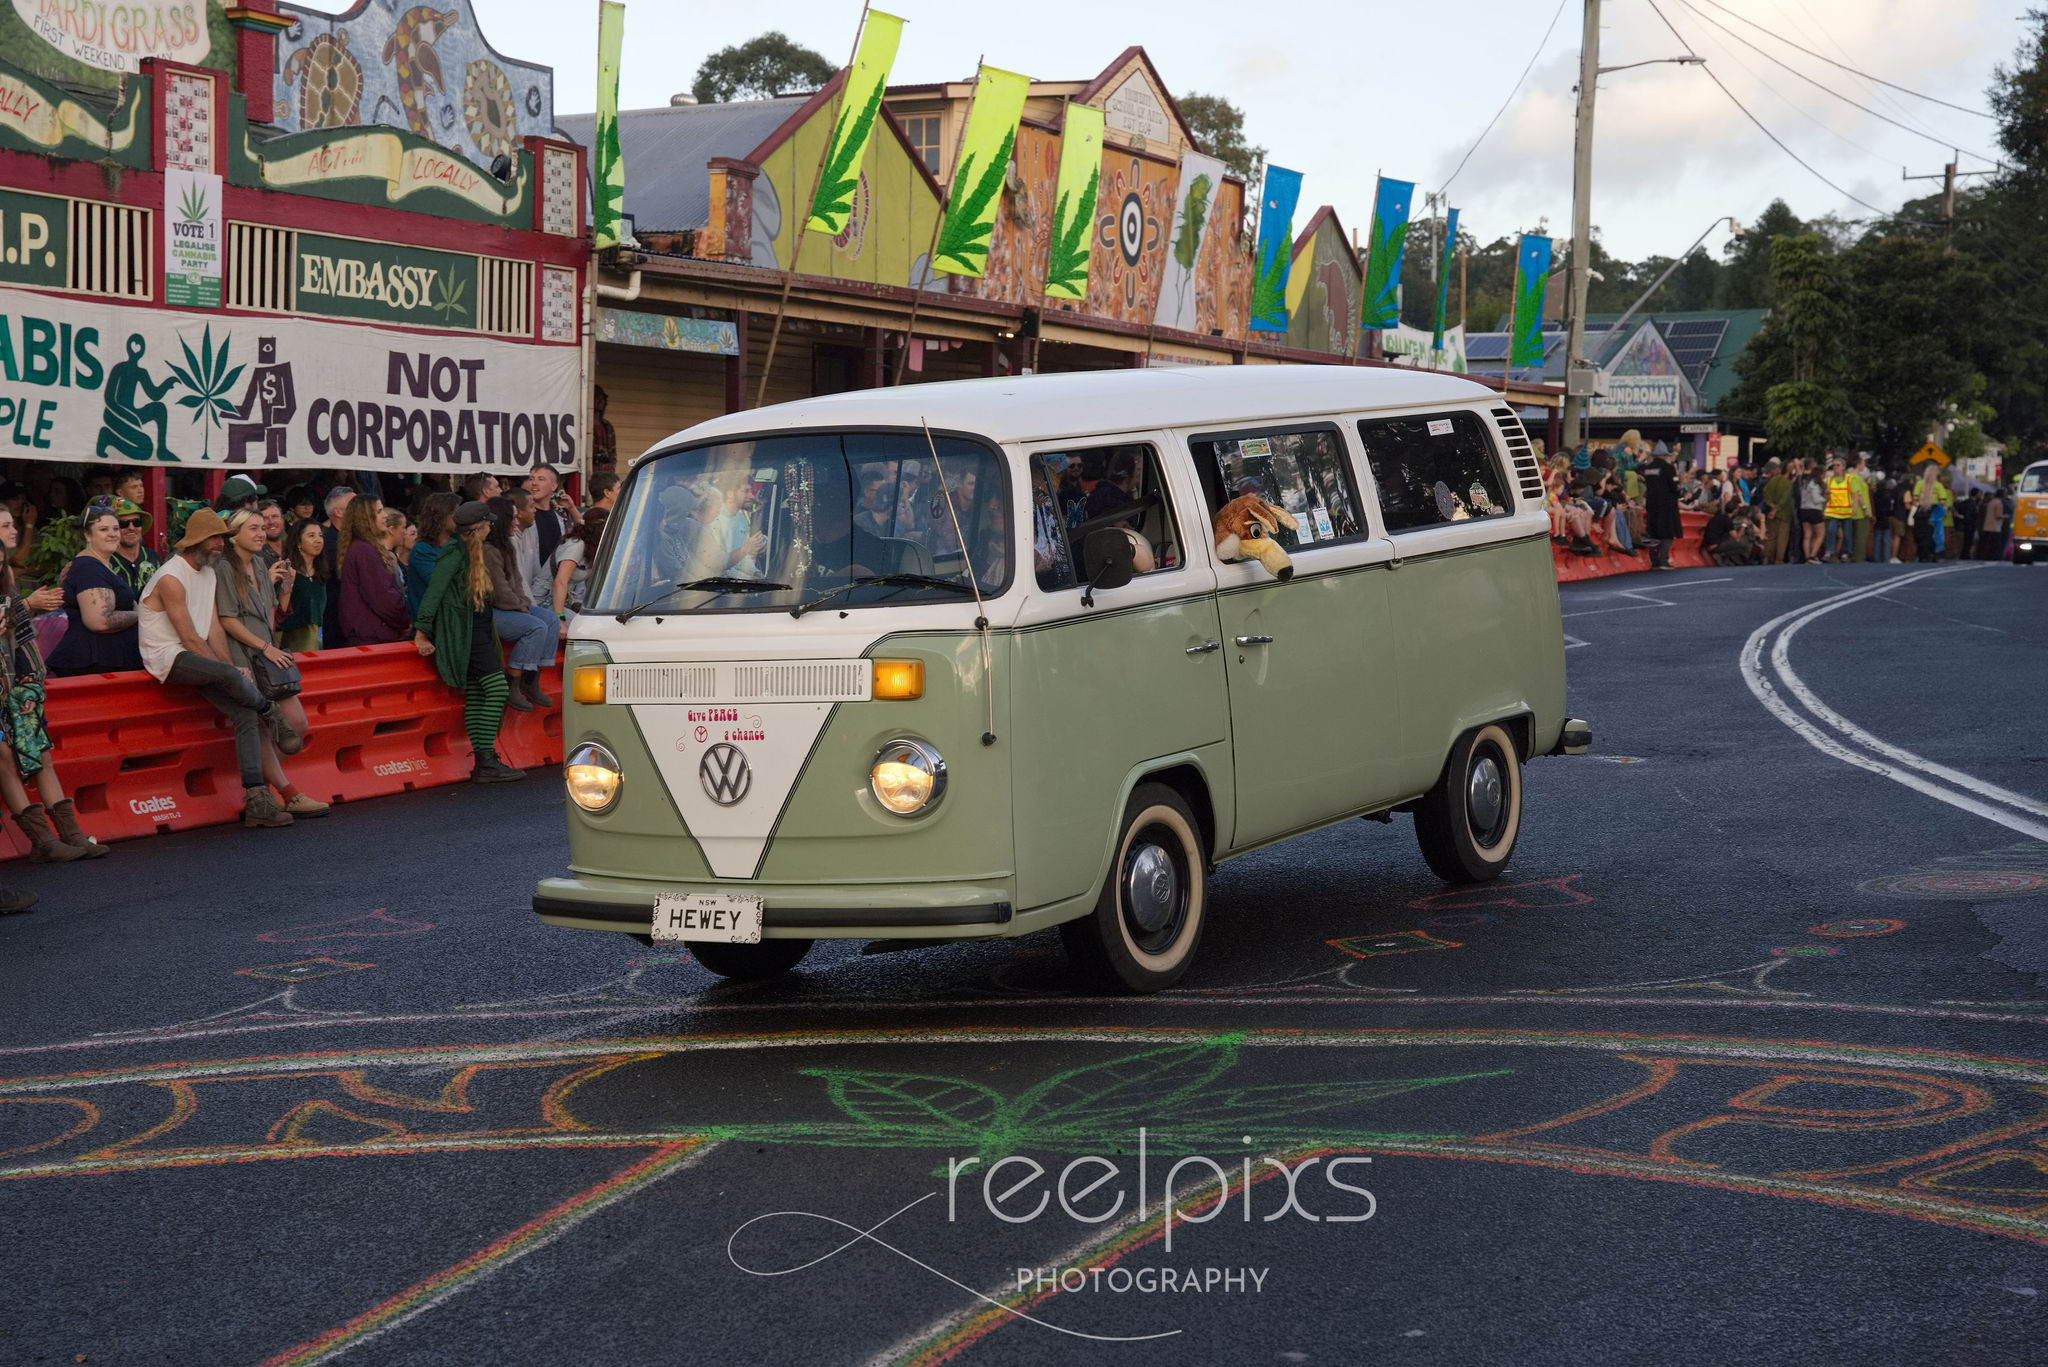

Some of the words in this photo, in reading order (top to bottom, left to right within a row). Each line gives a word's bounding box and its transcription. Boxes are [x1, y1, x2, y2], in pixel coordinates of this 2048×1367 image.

[111, 5, 200, 51] GRASS
[33, 15, 65, 46] FIRST
[72, 40, 125, 70] WEEKEND
[412, 156, 480, 192] LOCALLY
[0, 209, 56, 268] .P.
[172, 222, 205, 239] VOTE
[209, 222, 214, 239] 1
[171, 249, 217, 261] CANNABIS
[173, 239, 216, 252] LEGALISE
[181, 259, 208, 269] PARTY
[300, 253, 437, 310] EMBASSY
[386, 350, 485, 403] NOT
[1593, 384, 1677, 406] UNDROMAT
[1618, 406, 1644, 415] Down
[1646, 406, 1673, 415] Under
[307, 398, 575, 466] CORPORATIONS
[687, 709, 706, 722] Give
[708, 708, 738, 722] PEACE
[724, 730, 729, 741] a
[732, 728, 765, 741] chance
[129, 794, 176, 815] Coates
[669, 908, 742, 930] HEWEY
